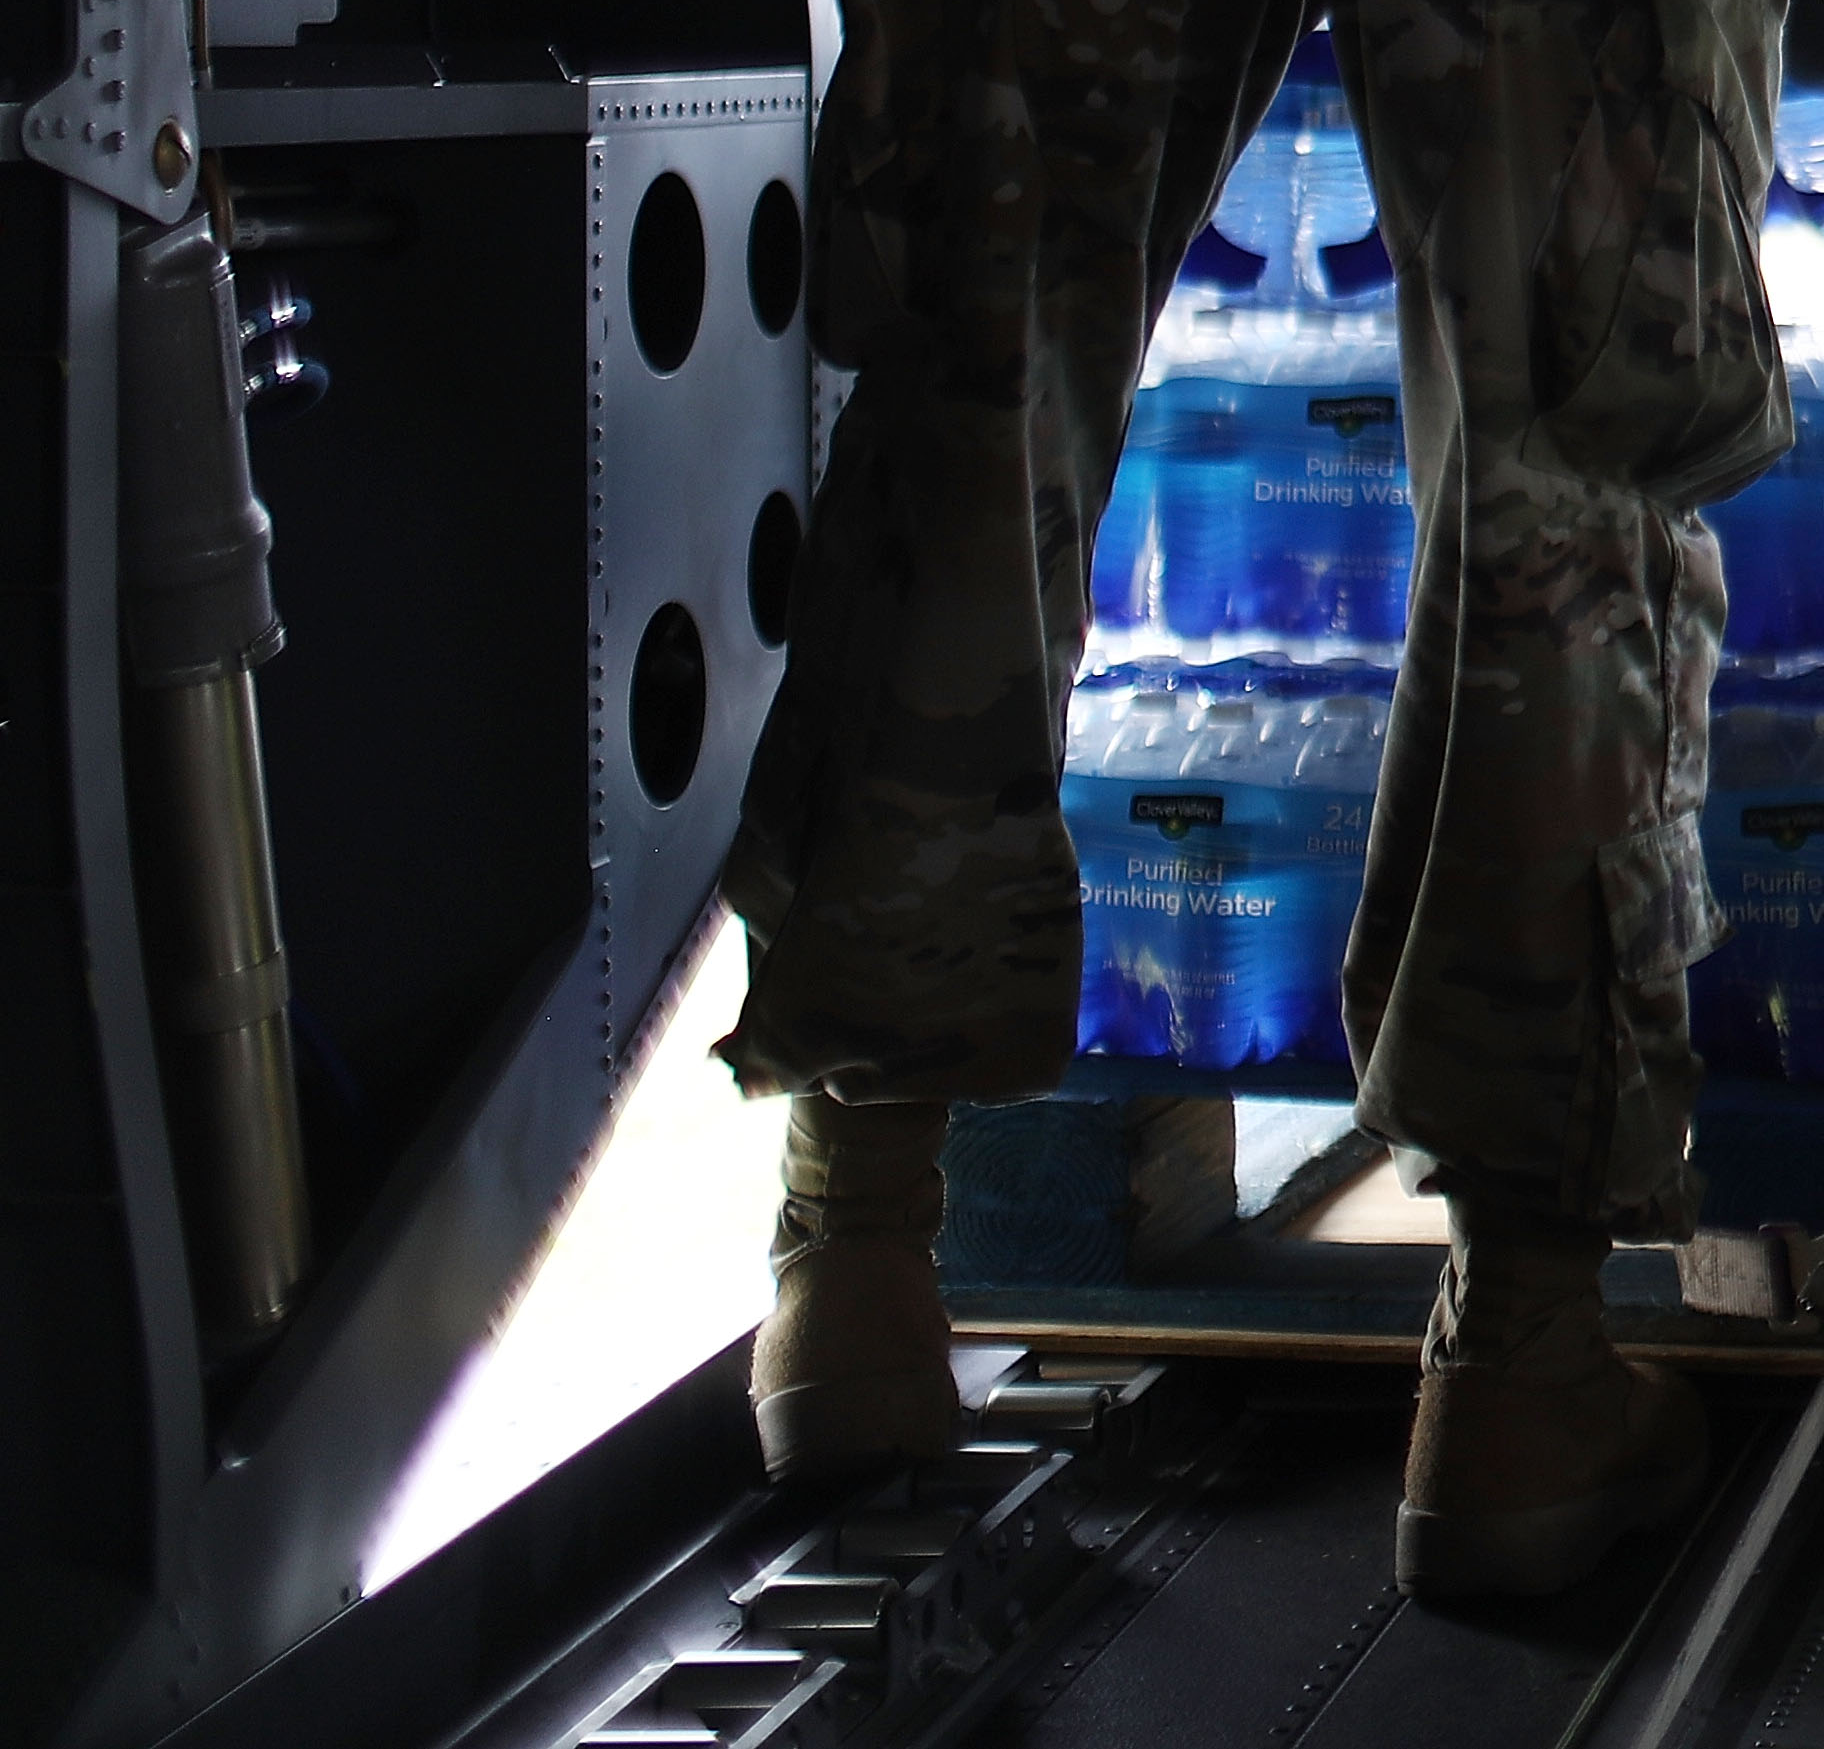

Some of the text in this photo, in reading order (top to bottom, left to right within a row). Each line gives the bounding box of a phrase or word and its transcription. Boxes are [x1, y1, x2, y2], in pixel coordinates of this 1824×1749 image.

[1306, 455, 1395, 478] Purified
[1254, 481, 1413, 508] Drinking Wat
[1322, 805, 1363, 831] 24
[1306, 835, 1367, 855] Bottle
[1127, 857, 1224, 887] Purified
[1079, 883, 1278, 918] Drinking Water
[1721, 901, 1800, 929] inking
